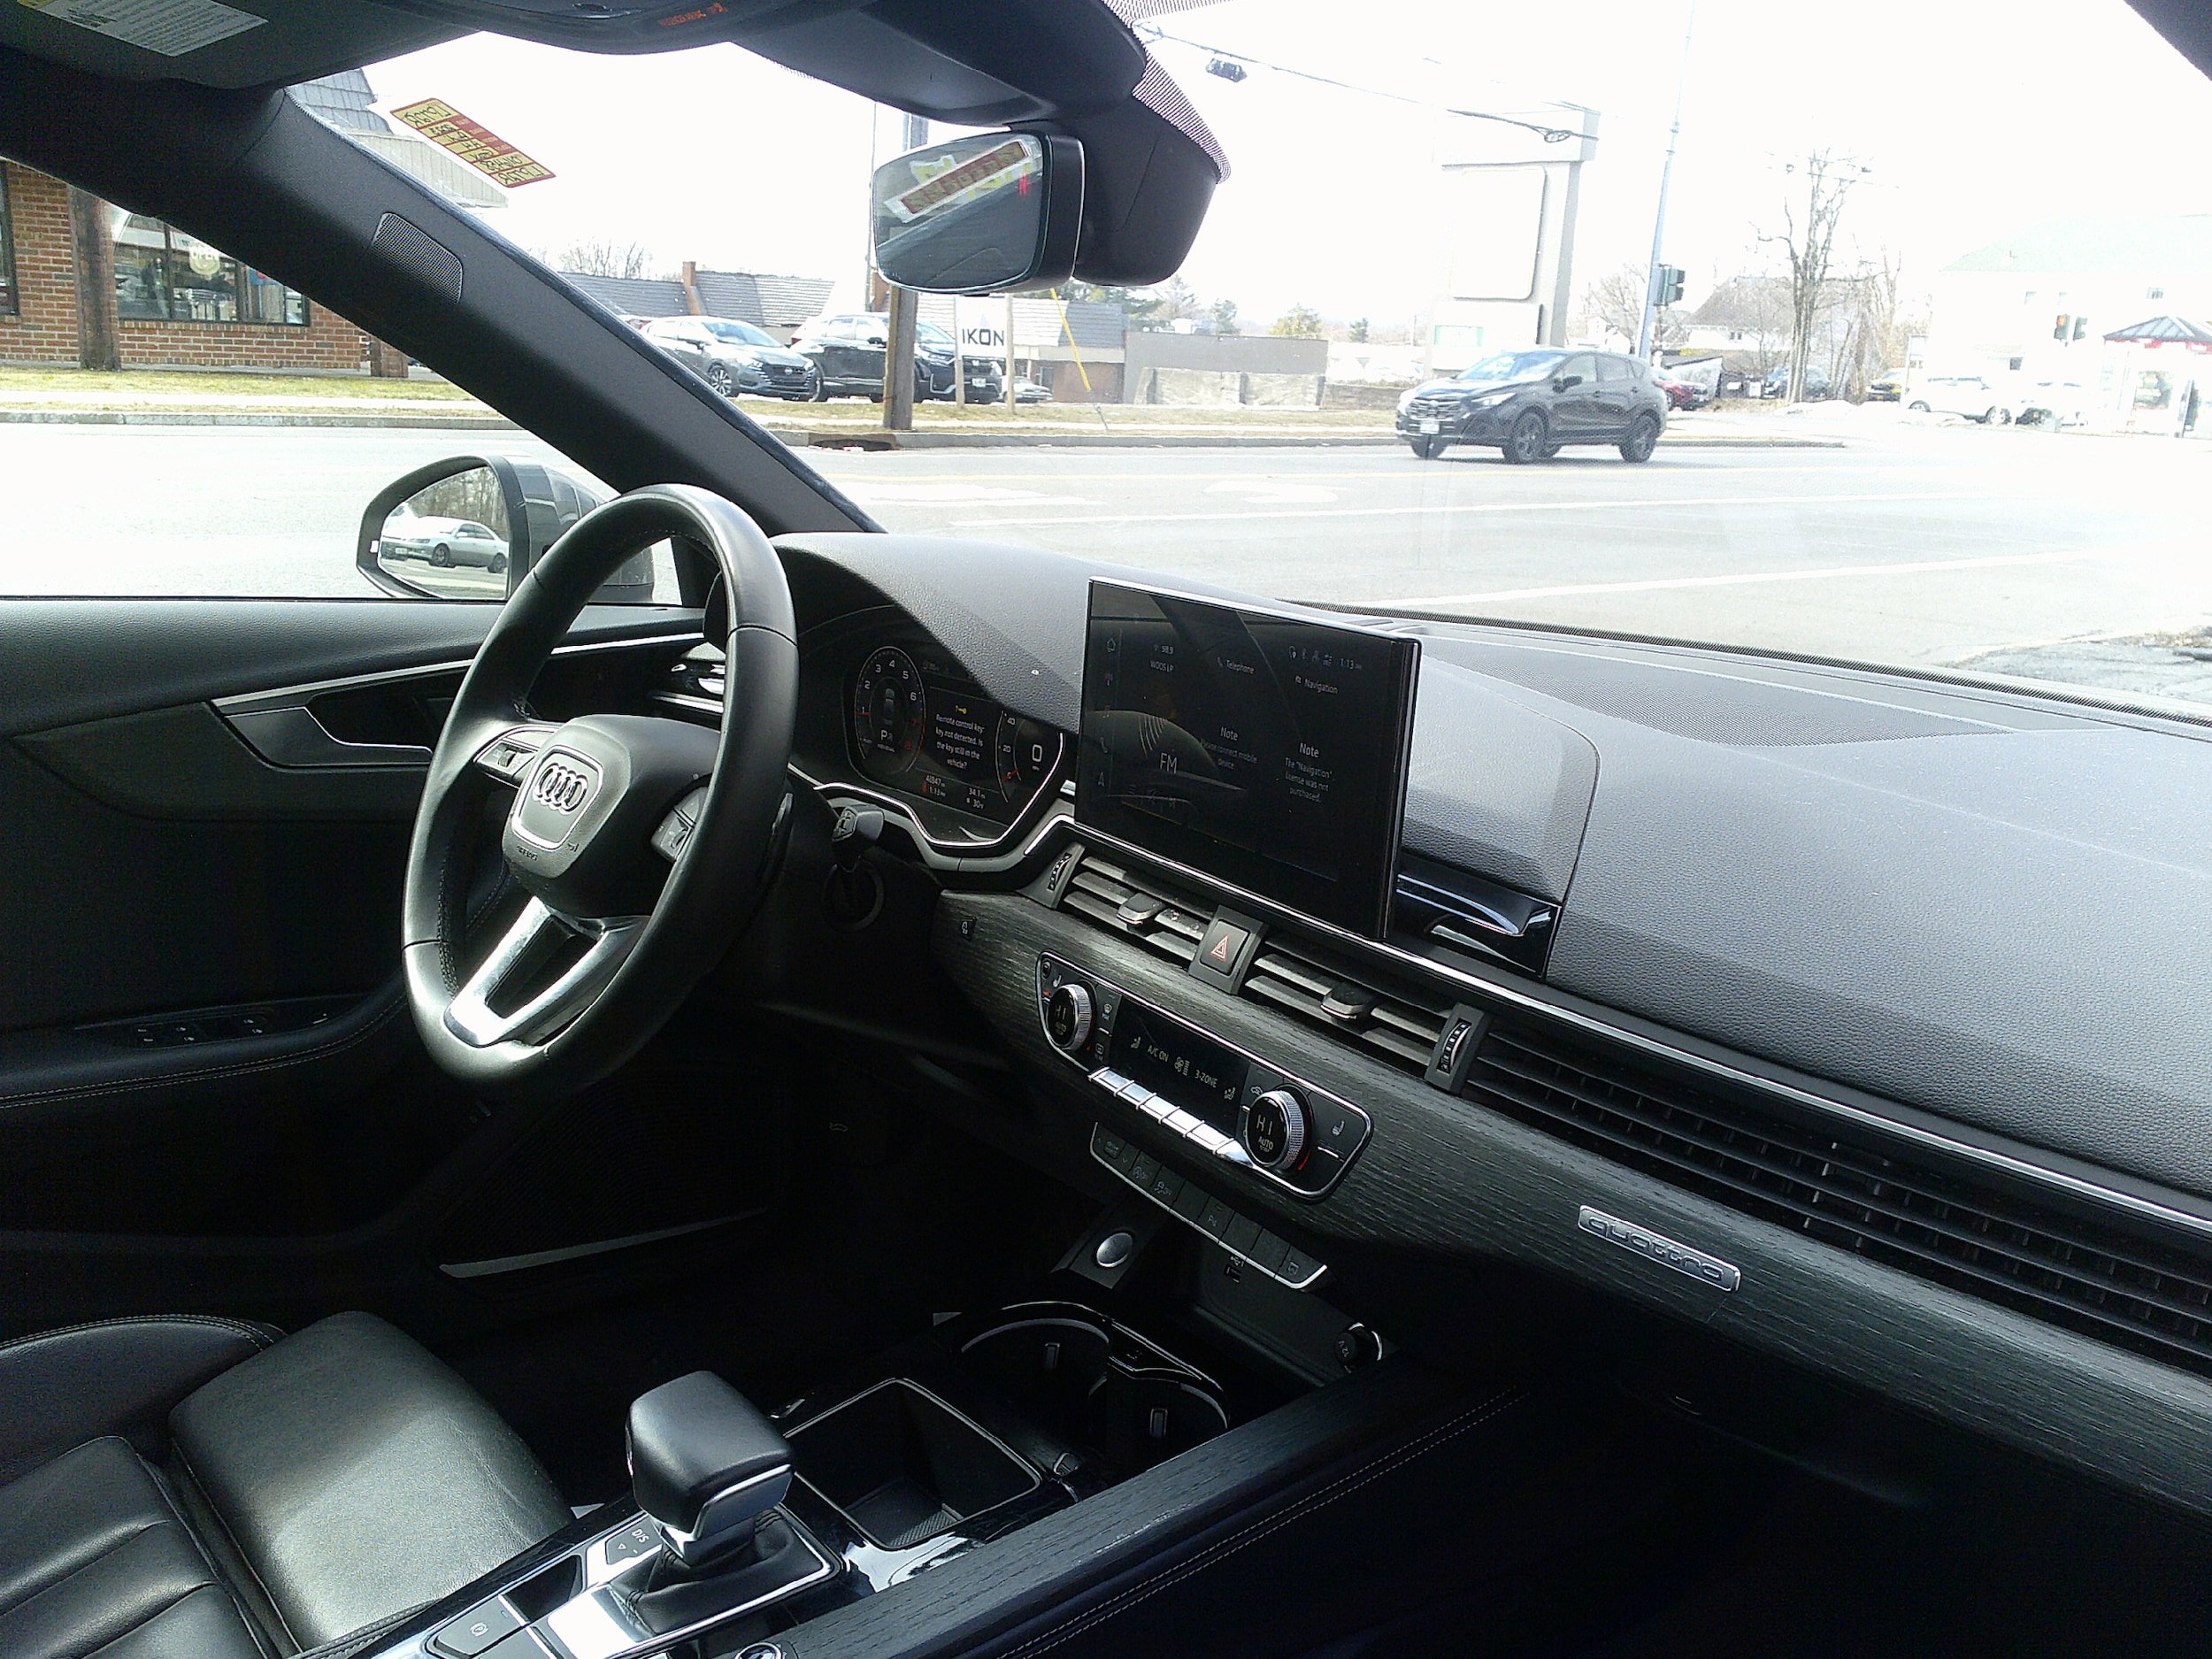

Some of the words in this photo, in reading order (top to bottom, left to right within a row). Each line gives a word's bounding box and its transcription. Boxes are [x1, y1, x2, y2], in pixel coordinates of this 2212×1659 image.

[963, 328, 1004, 346] IKON
[1226, 659, 1255, 675] Telephone
[902, 671, 909, 680] 5
[864, 680, 871, 689] 2
[1305, 678, 1338, 695] Navigation
[910, 692, 917, 701] 6
[936, 714, 955, 726] Remote
[956, 719, 973, 731] control
[880, 730, 888, 741] P
[944, 730, 953, 740] not
[954, 733, 977, 745] detected.
[1220, 726, 1239, 741] Note
[971, 750, 979, 759] the
[1002, 744, 1010, 753] 20
[1032, 744, 1042, 762] 0
[1300, 742, 1319, 758] Note
[947, 759, 967, 770] vehicle?
[1160, 753, 1178, 774] FM
[1239, 752, 1257, 764] mobile
[1286, 757, 1294, 769] The
[1305, 779, 1317, 789] was
[1317, 783, 1330, 792] not
[1148, 1044, 1159, 1057] A/C
[1159, 1051, 1169, 1063] ON
[1194, 1070, 1218, 1088] 3-ZONE
[1258, 1135, 1274, 1150] AUTO
[1588, 1215, 1725, 1282] quattro
[631, 1528, 649, 1544] D/S
